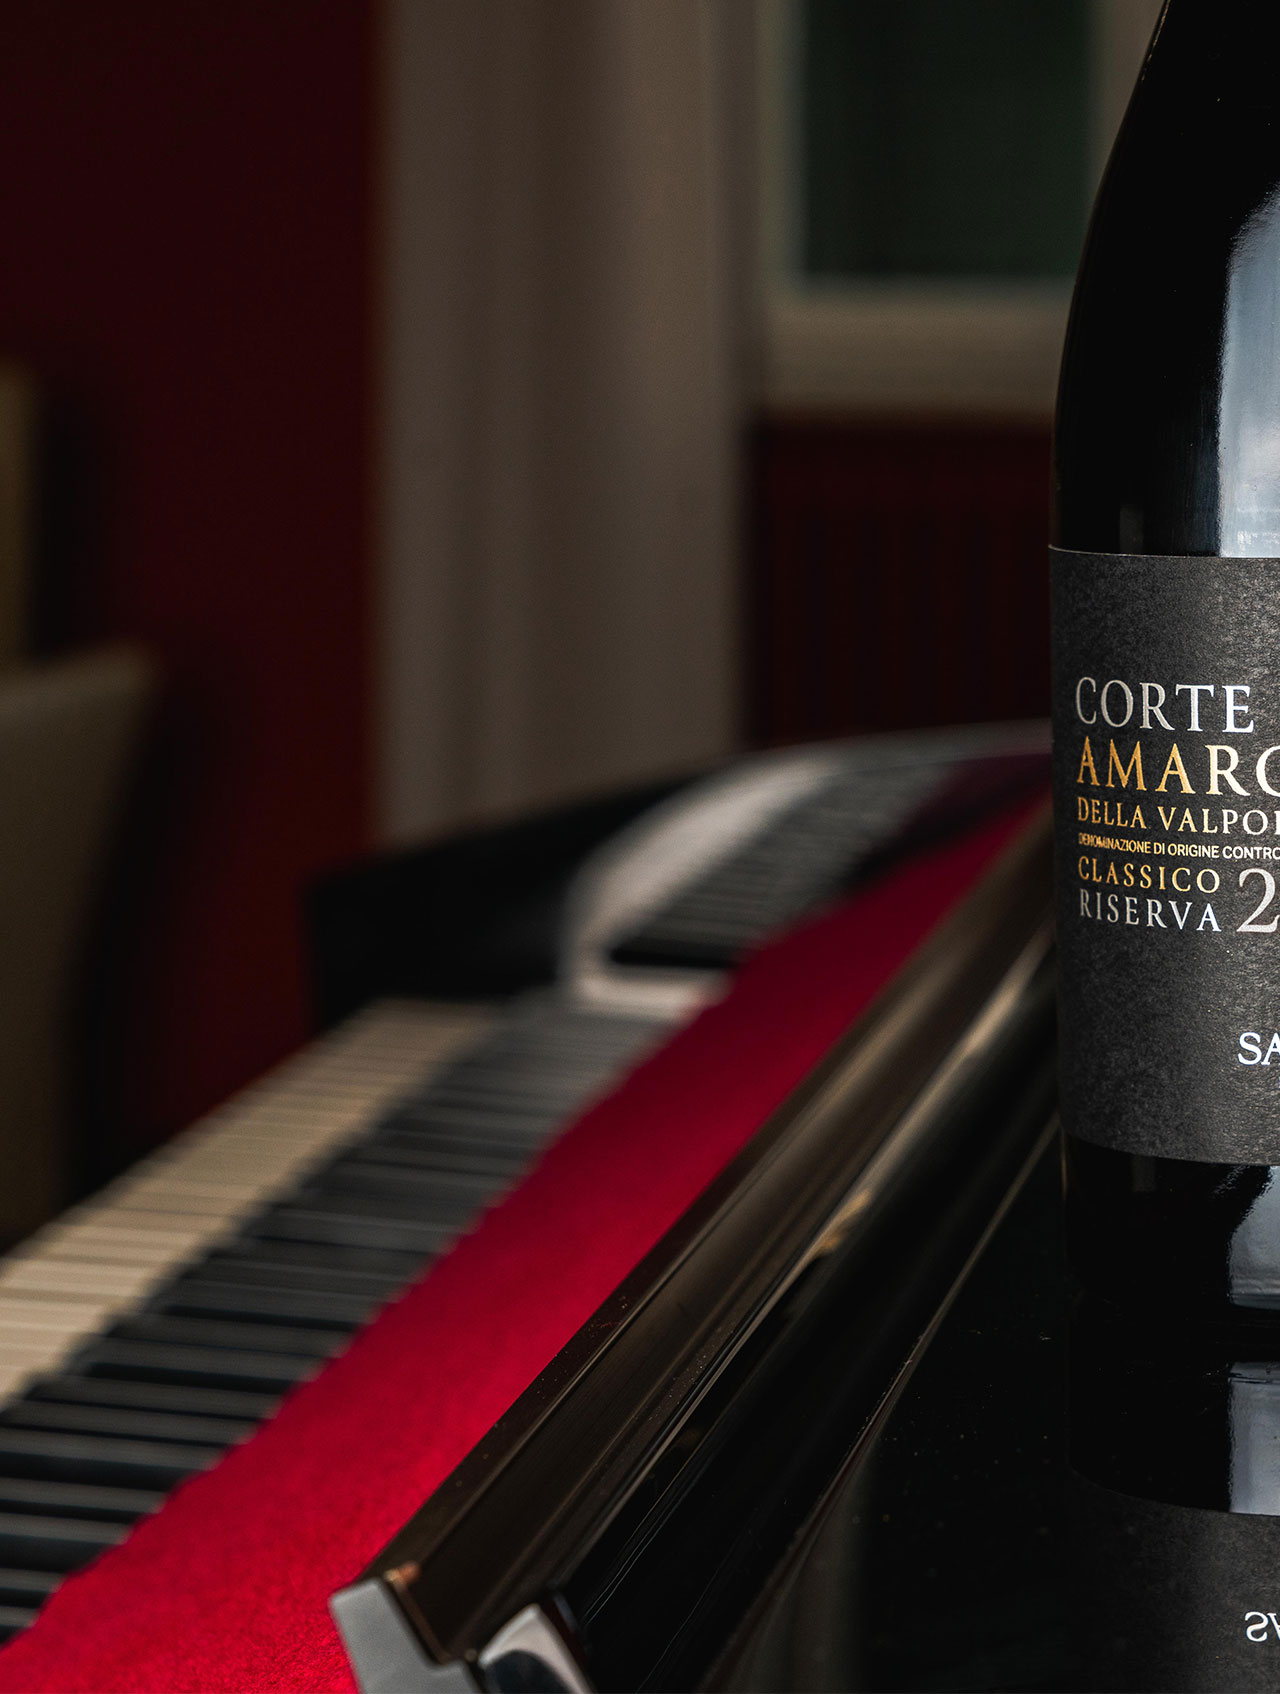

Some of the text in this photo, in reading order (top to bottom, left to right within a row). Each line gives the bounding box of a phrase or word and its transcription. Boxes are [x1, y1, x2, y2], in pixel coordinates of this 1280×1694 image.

[1075, 677, 1254, 733] CORTE
[1077, 797, 1148, 829] DELLA
[1078, 833, 1151, 854] DENOMINAZIONE
[1153, 843, 1165, 855] DI
[1168, 844, 1219, 858] ORIGINE
[1078, 856, 1220, 893] CLASSICO
[1078, 889, 1221, 932] RISERVA
